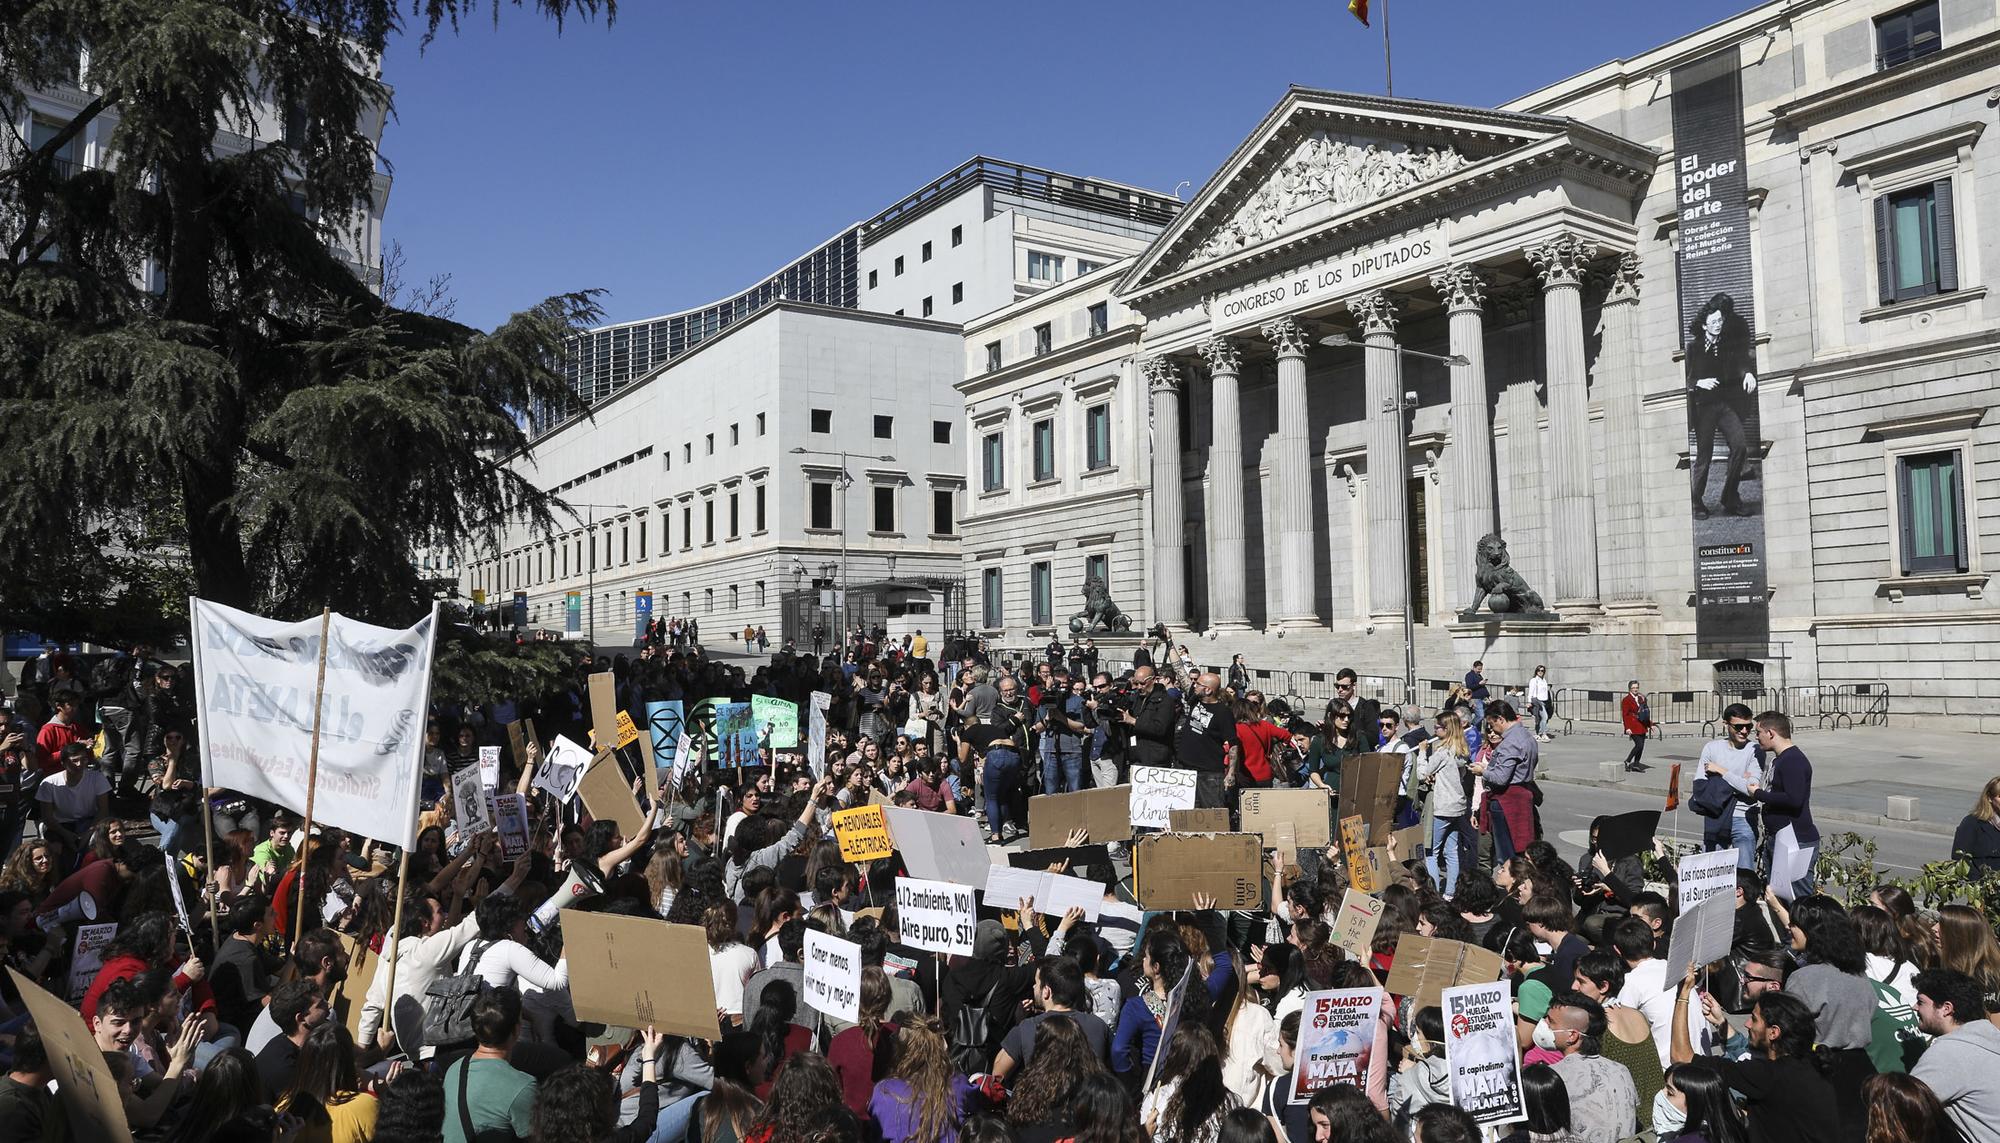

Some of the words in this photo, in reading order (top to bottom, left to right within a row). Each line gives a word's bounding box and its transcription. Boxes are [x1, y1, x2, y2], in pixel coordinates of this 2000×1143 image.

[1681, 154, 1698, 173] El
[1682, 160, 1737, 190] poder
[1683, 183, 1711, 204] del
[1684, 200, 1722, 220] arte
[1684, 225, 1708, 235] Obras
[1710, 221, 1720, 229] de
[1694, 226, 1733, 240] colección
[1685, 243, 1698, 252] del
[1700, 236, 1727, 248] Museo
[1685, 249, 1709, 260] Reina
[1711, 243, 1732, 253] Sofía
[1223, 287, 1286, 317] CONGRESO
[1294, 279, 1310, 297] DE
[1318, 269, 1342, 289] LOS
[1352, 240, 1432, 279] DIPUTADOS
[1700, 544, 1751, 556] constitución
[1134, 767, 1197, 788] CRISIS
[844, 811, 882, 832] RENOVABLES
[1681, 868, 1692, 882] Los
[1693, 866, 1706, 880] ricos
[897, 886, 912, 908] 1/2
[912, 888, 953, 915] ambiente,
[954, 893, 970, 914] NO!
[1681, 892, 1686, 906] y
[1685, 887, 1691, 902] al
[1693, 887, 1704, 901] Sur
[1351, 915, 1358, 926] is
[1358, 917, 1366, 928] in
[901, 917, 922, 939] Aire
[922, 924, 952, 948] puro,
[955, 918, 973, 946] SÍ!
[1348, 927, 1360, 939] the
[1343, 940, 1356, 949] air
[811, 942, 828, 963] Comer
[830, 953, 851, 975] menos,
[815, 976, 826, 996] más
[827, 985, 833, 1004] y
[1315, 999, 1331, 1013] 15
[1331, 996, 1373, 1008] MARZO
[1450, 995, 1464, 1014] 15
[1464, 990, 1501, 1008] MARZO
[1329, 1013, 1370, 1022] ESTUDIANTIL
[1466, 1006, 1490, 1016] HUELGA
[1467, 1012, 1504, 1025] ESTUDIANTIL
[1328, 1020, 1359, 1028] EUROPEA
[1469, 1022, 1497, 1033] EUROPEA
[1311, 1054, 1318, 1062] El
[1319, 1052, 1359, 1062] capitalismo
[1308, 1060, 1357, 1080] MATA
[1459, 1066, 1466, 1076] El
[1466, 1062, 1505, 1076] capitalismo
[1306, 1079, 1315, 1090] el
[1460, 1073, 1508, 1100] MATA
[1472, 1093, 1510, 1111] PLANETA
